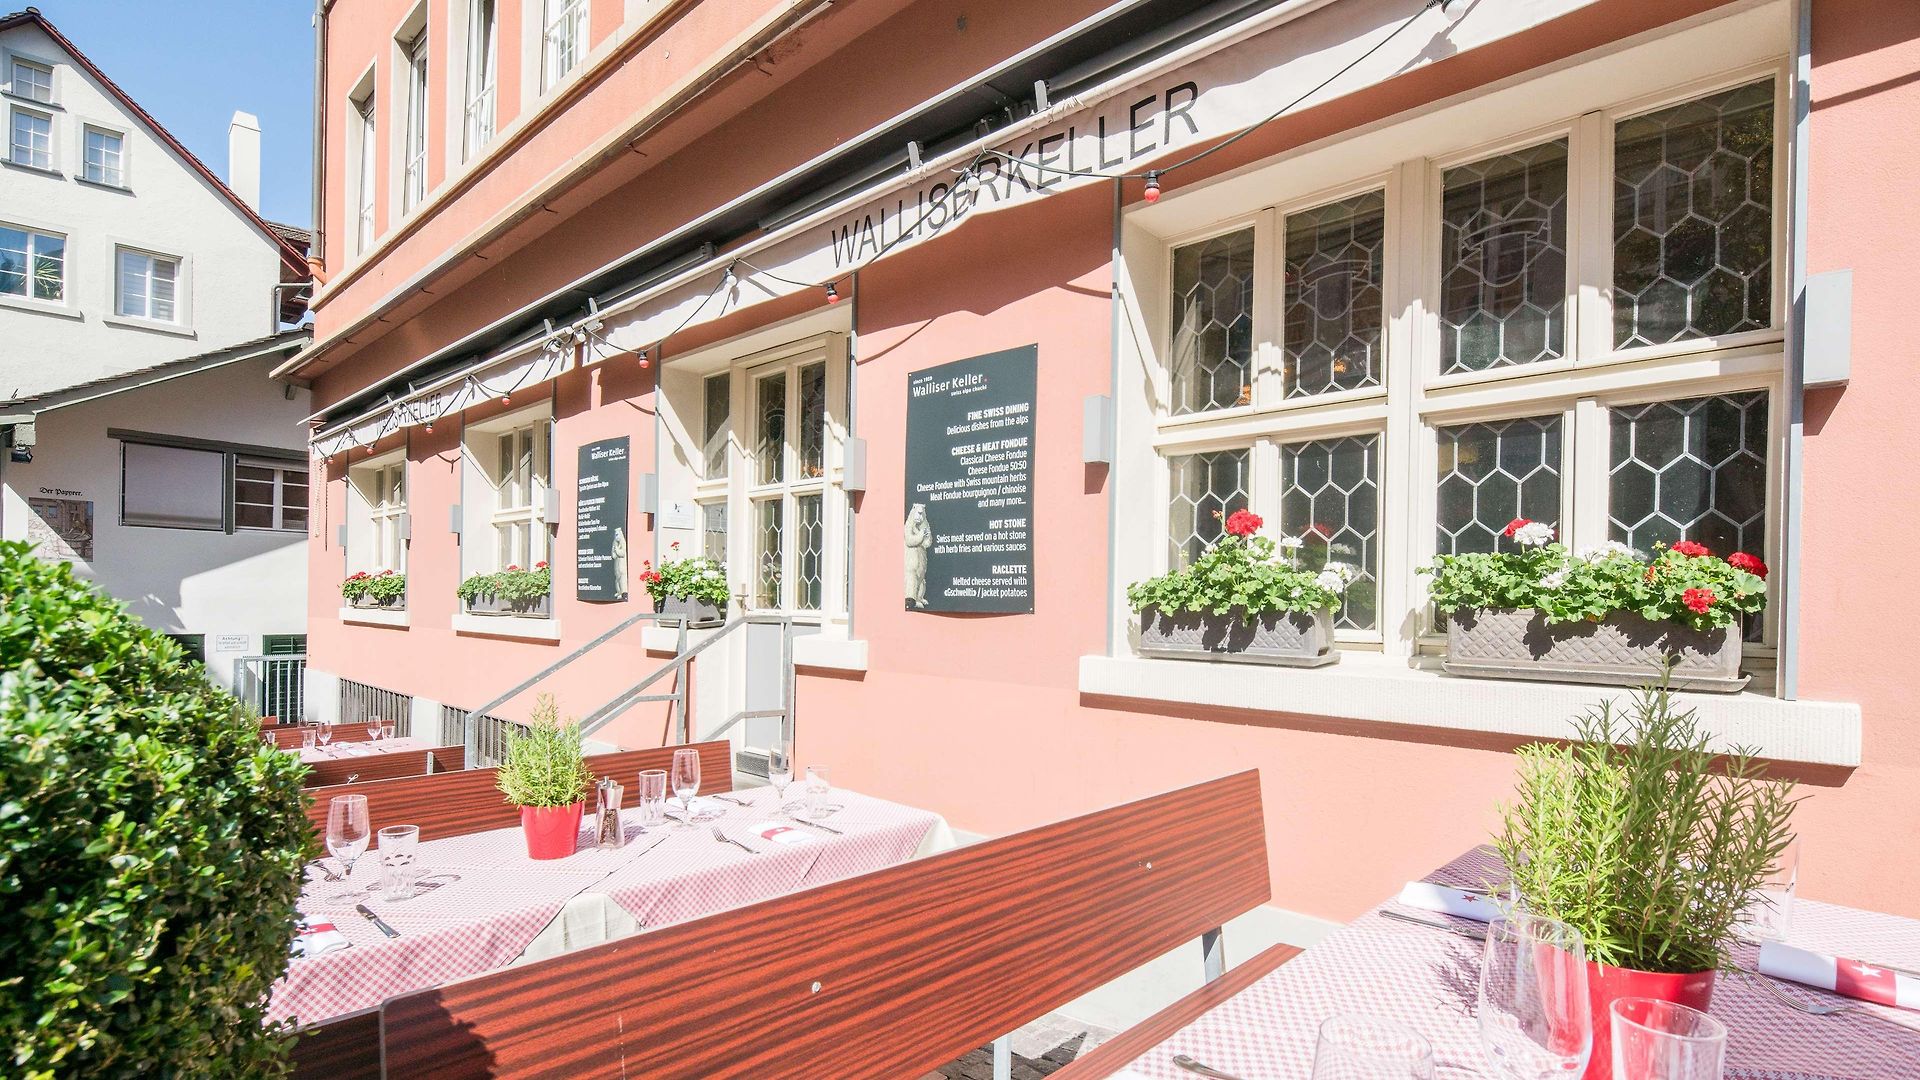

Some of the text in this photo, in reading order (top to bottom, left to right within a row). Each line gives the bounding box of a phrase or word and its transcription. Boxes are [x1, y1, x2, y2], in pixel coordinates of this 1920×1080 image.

[913, 373, 983, 397] Walliser Keller
[967, 402, 1029, 421] FINE SWISS DINING
[946, 415, 1029, 435] Delicious dishes from the alps
[951, 437, 1028, 456] CHEESE & MEAT FONDUE
[960, 449, 1027, 465] Classical Cheese Fondue
[967, 460, 1027, 475] Cheese Fondue 50:50
[917, 472, 1027, 492] Cheese Fondue with Swiss mountain herbs
[943, 490, 962, 500] Fondue
[962, 487, 997, 499] bourguignon
[1001, 484, 1026, 494] chinoise
[977, 499, 989, 508] and
[989, 499, 1006, 508] many
[989, 518, 1027, 529] HOT STONE
[936, 534, 951, 543] Swiss
[951, 533, 965, 543] meat
[965, 532, 984, 542] served
[998, 531, 1009, 540] hot
[1009, 530, 1027, 540] stone
[934, 542, 1027, 554] with herb fries and various sauces
[992, 564, 1027, 575] RACLETTE
[971, 576, 992, 586] cheese
[992, 576, 1013, 586] served
[1013, 576, 1028, 586] with
[981, 588, 1000, 598] jacket
[1000, 588, 1028, 598] potatoes
